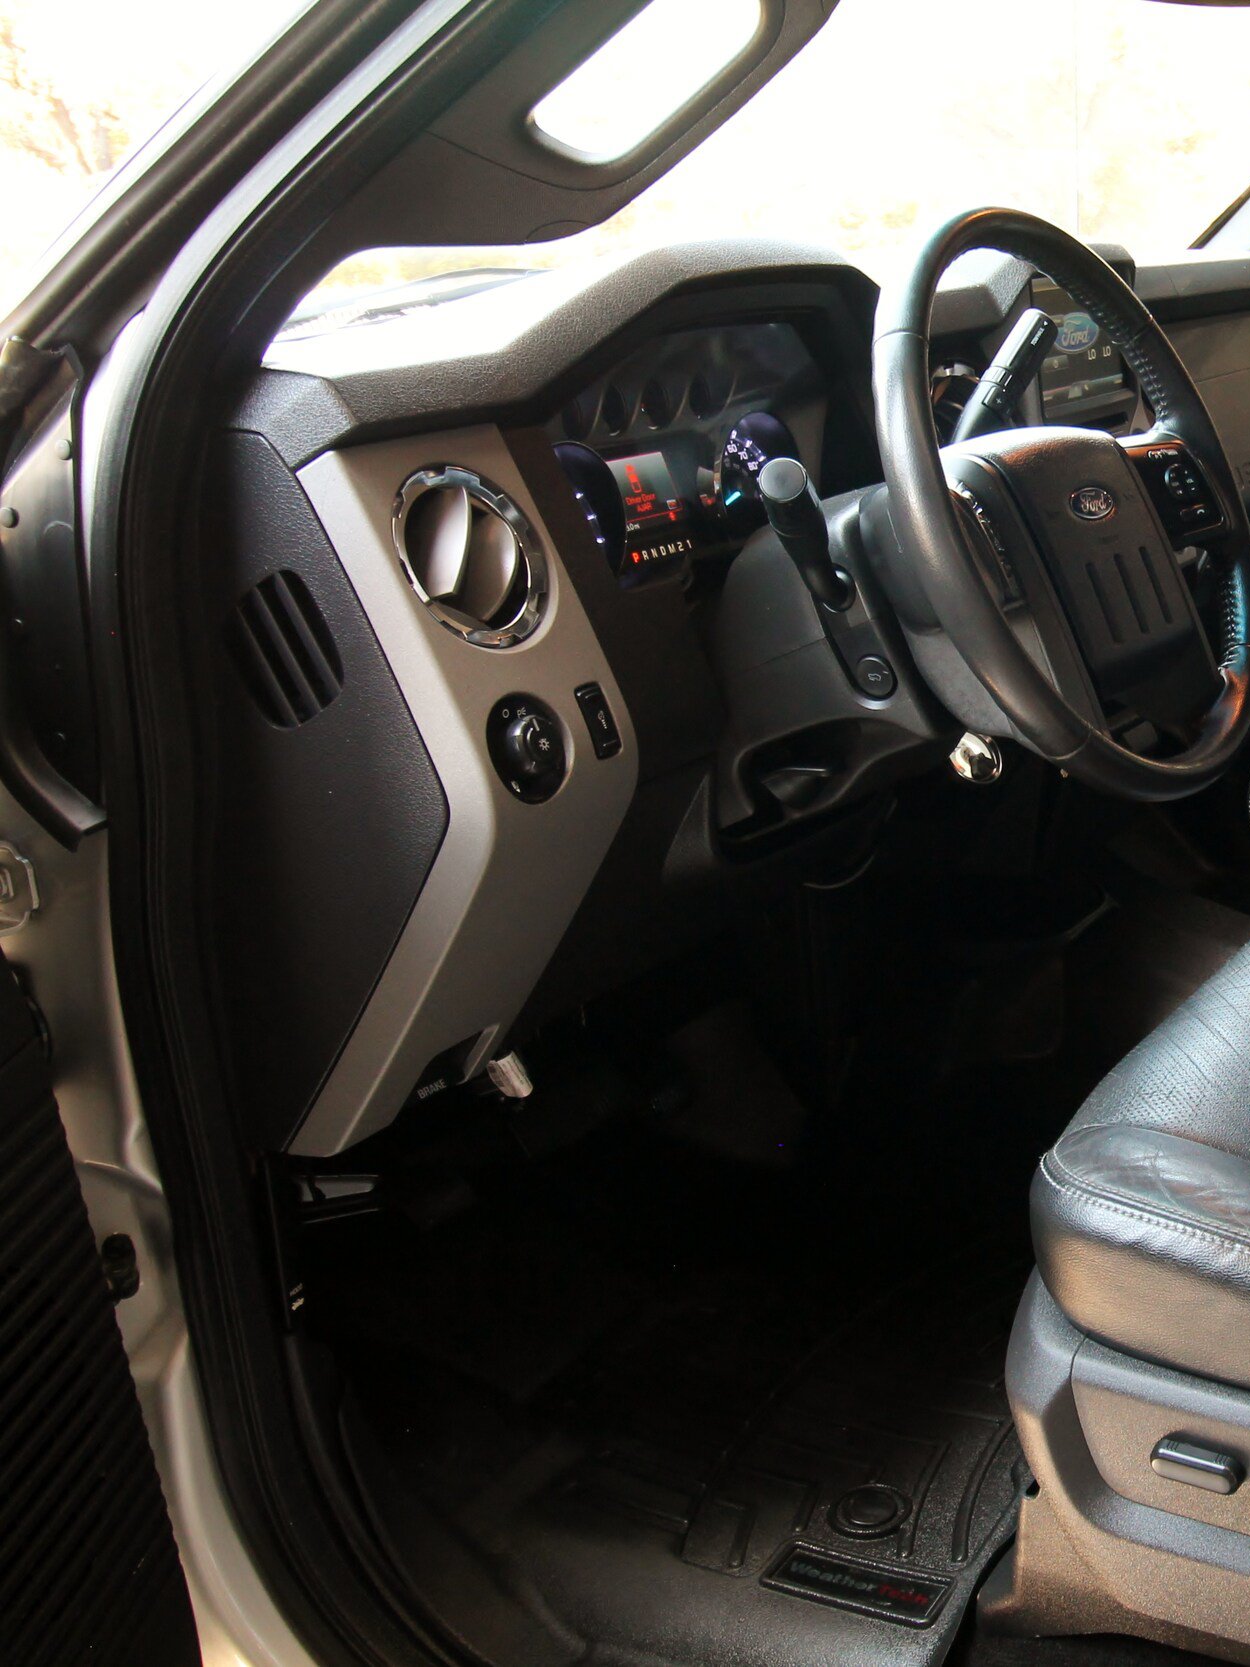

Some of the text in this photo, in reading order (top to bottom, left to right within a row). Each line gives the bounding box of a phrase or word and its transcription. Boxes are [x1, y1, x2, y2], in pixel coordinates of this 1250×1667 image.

[1061, 320, 1090, 347] Ford
[1087, 346, 1112, 360] LO LO
[737, 451, 748, 460] 70
[1080, 491, 1107, 512] Ford
[631, 539, 692, 563] P R N D M 2 1
[417, 1078, 448, 1099] BRAKE
